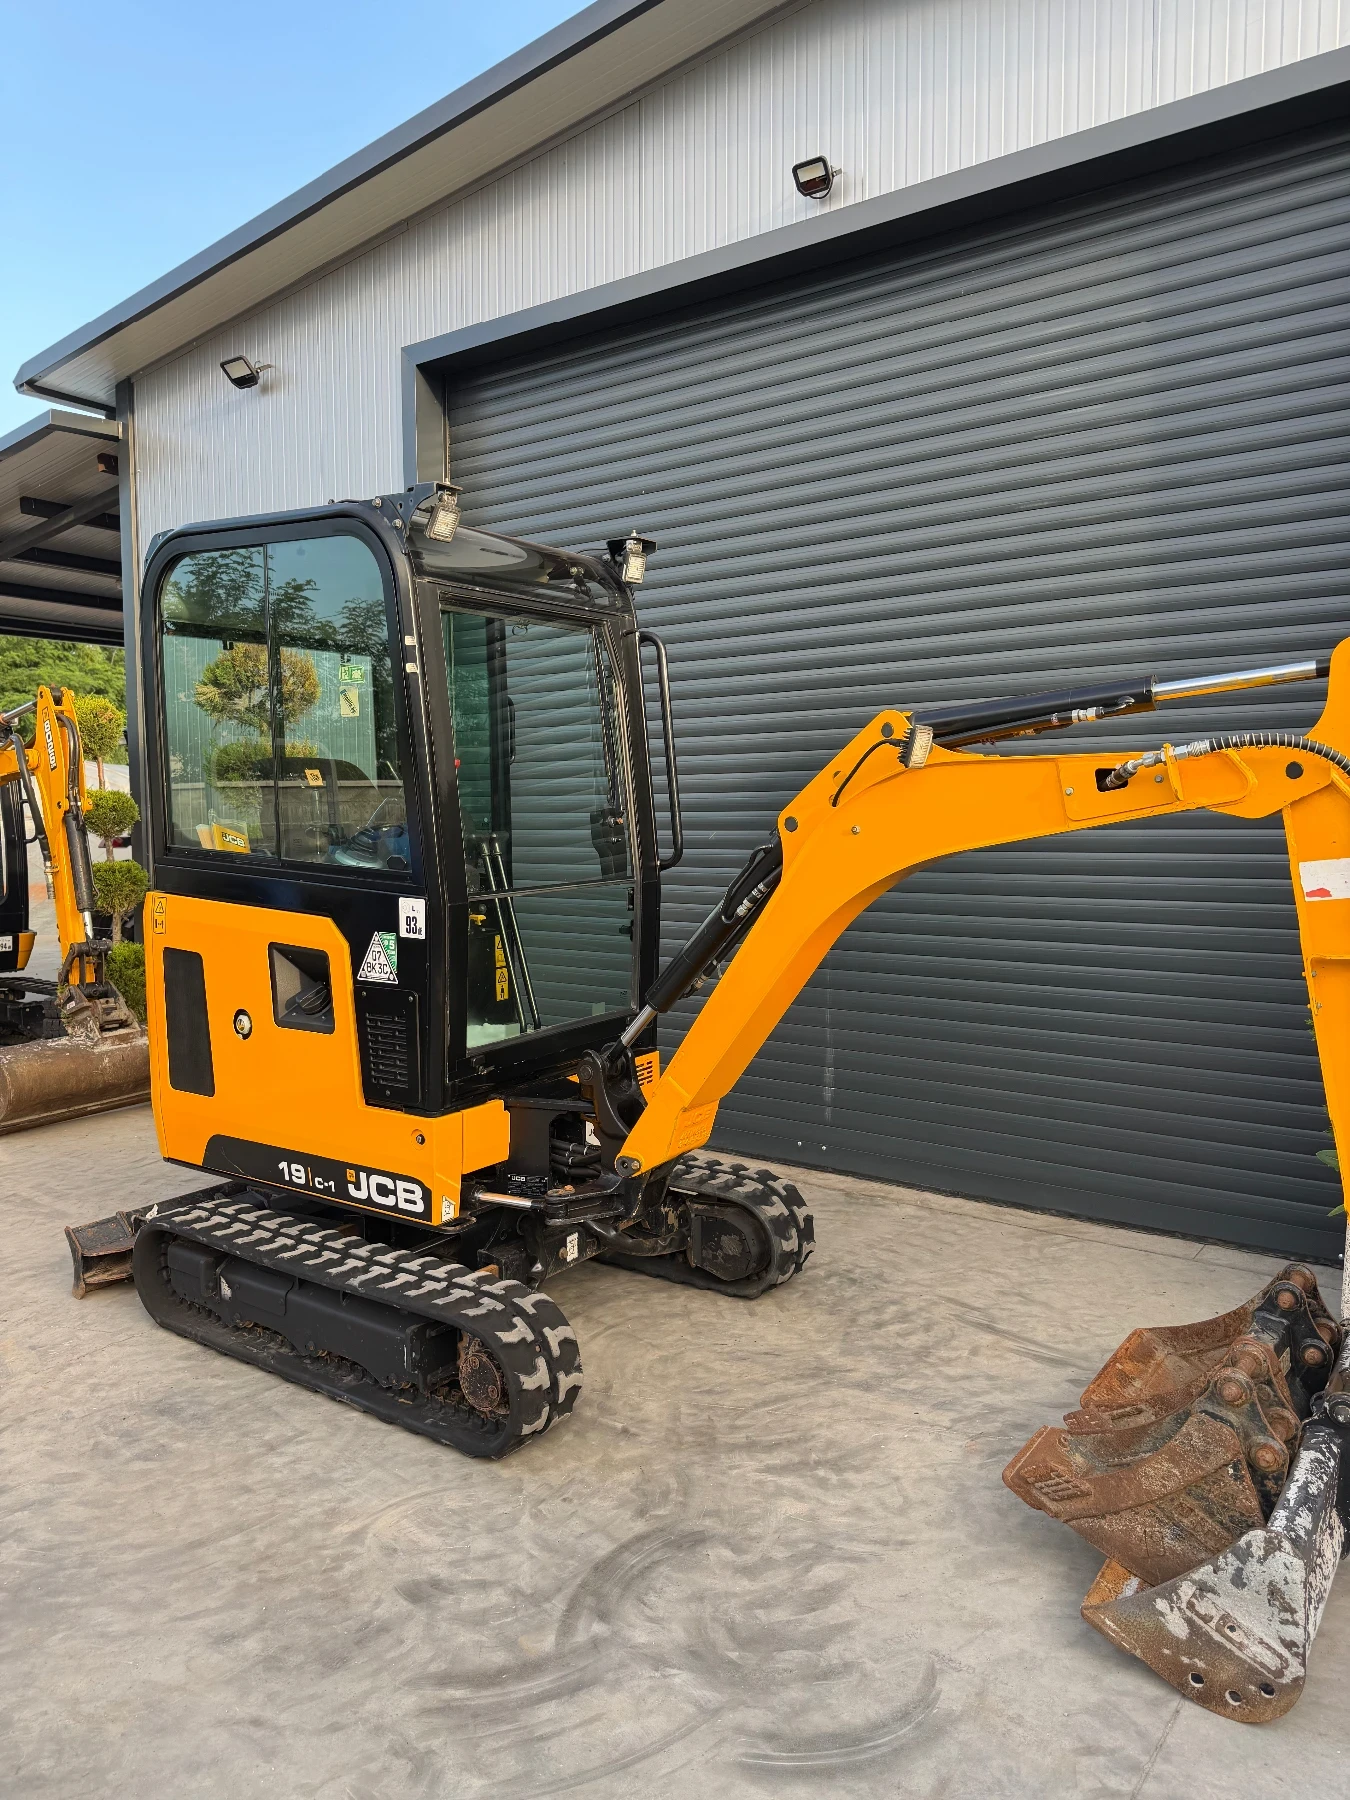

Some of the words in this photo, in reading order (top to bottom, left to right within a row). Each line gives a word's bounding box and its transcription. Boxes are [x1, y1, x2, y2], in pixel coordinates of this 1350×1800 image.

[222, 832, 246, 848] JCB
[405, 916, 418, 934] 93
[278, 1160, 306, 1185] 19
[347, 1170, 425, 1213] JCB
